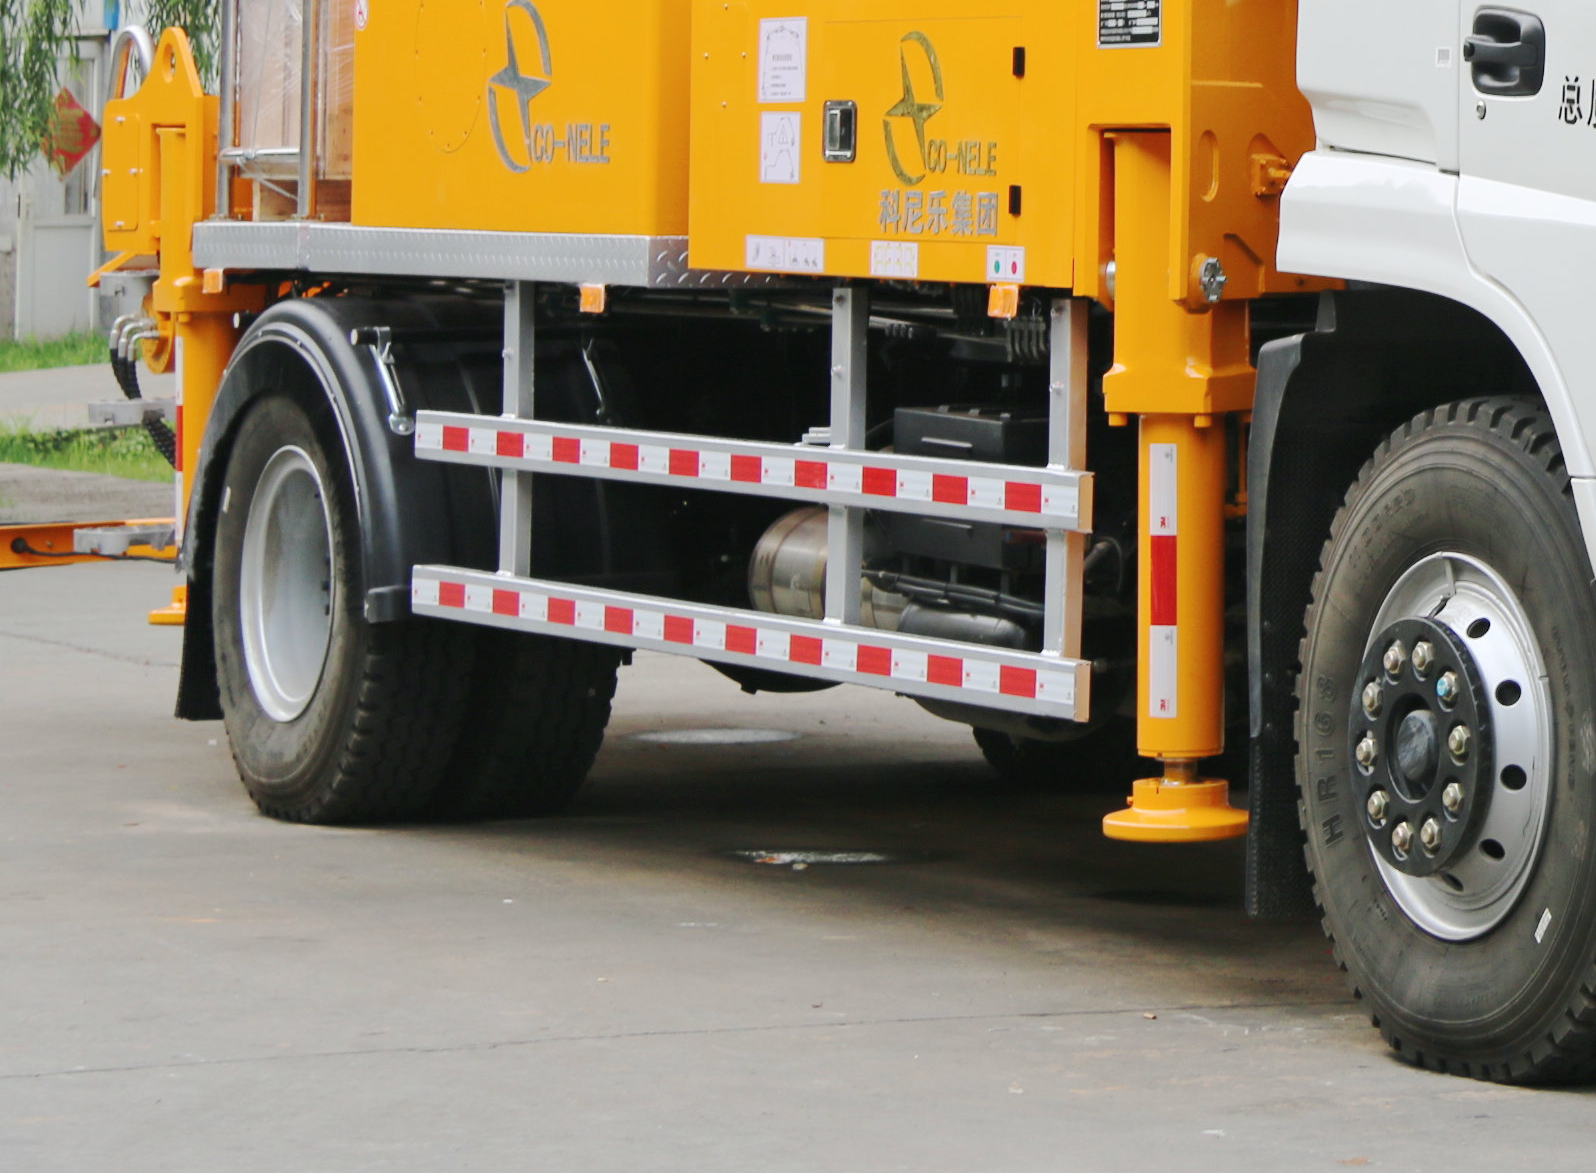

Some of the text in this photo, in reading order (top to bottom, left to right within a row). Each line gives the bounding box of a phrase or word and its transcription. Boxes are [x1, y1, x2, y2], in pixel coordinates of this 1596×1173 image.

[532, 123, 611, 164] CO-NELE
[927, 139, 998, 177] CO-NELE
[879, 188, 999, 237] 科尼乐集团
